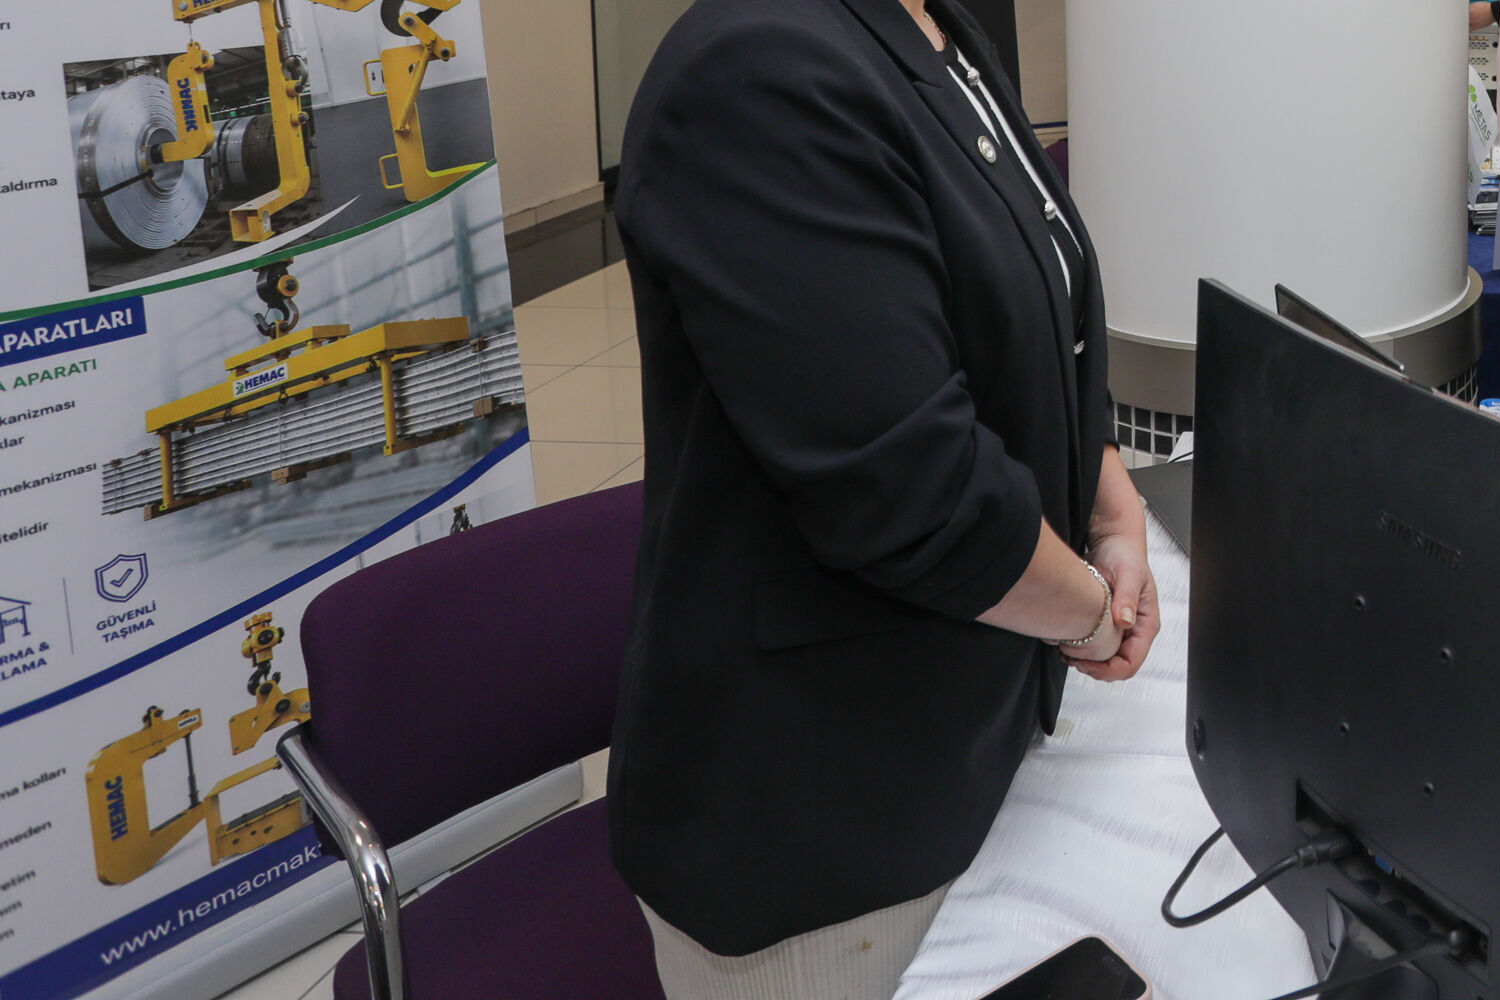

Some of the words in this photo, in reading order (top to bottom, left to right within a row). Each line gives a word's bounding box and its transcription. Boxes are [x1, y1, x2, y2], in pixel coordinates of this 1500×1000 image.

[0, 176, 58, 194] aldırma
[13, 358, 97, 390] APARATI
[244, 367, 285, 390] HEMAC
[0, 462, 97, 497] mekanizması
[1376, 510, 1462, 571] SAMSUNG
[96, 600, 157, 632] GÜVENLİ
[102, 618, 155, 644] TAŞIMA
[38, 641, 50, 652] &
[105, 775, 128, 841] HEMAC
